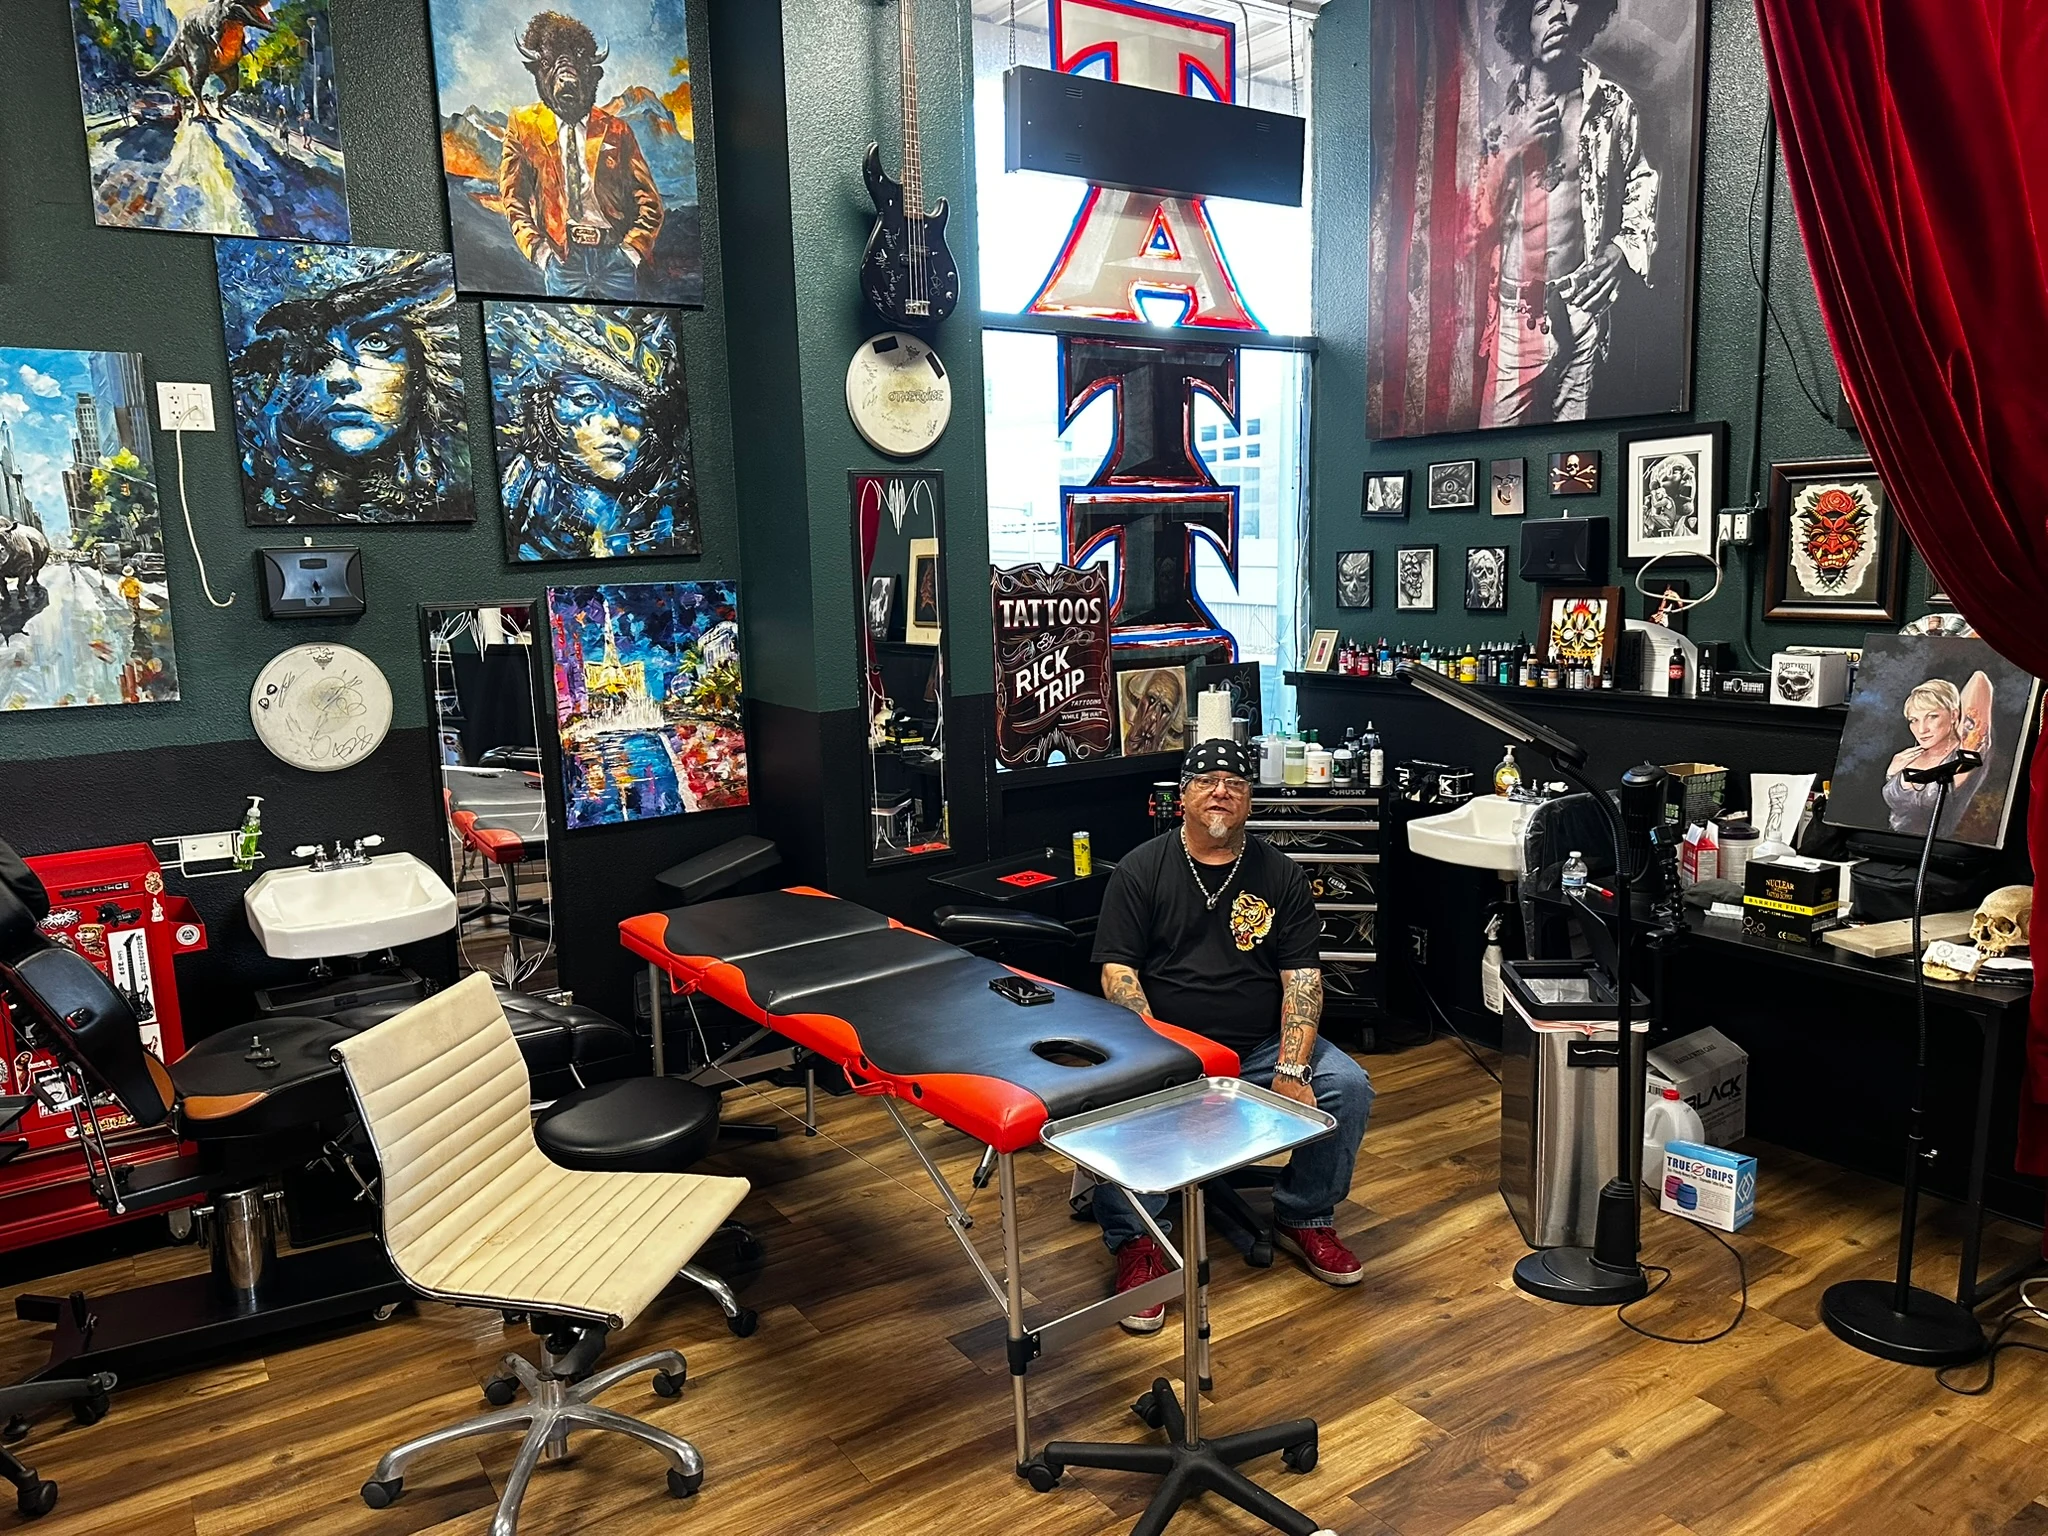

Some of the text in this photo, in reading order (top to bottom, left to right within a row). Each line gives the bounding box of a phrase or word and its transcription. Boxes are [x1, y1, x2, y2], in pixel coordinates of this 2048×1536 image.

[1000, 598, 1101, 628] TATTOOS
[1015, 646, 1070, 698] RICK
[1034, 669, 1085, 714] TRIP
[1071, 699, 1102, 707] TATTOOING
[1328, 877, 1347, 890] FUSION
[1766, 879, 1795, 890] NUCLEAR
[1748, 898, 1806, 913] BARRIER FILM
[1683, 1074, 1742, 1111] BLACK
[1666, 1156, 1734, 1184] TRUE GRIPS
